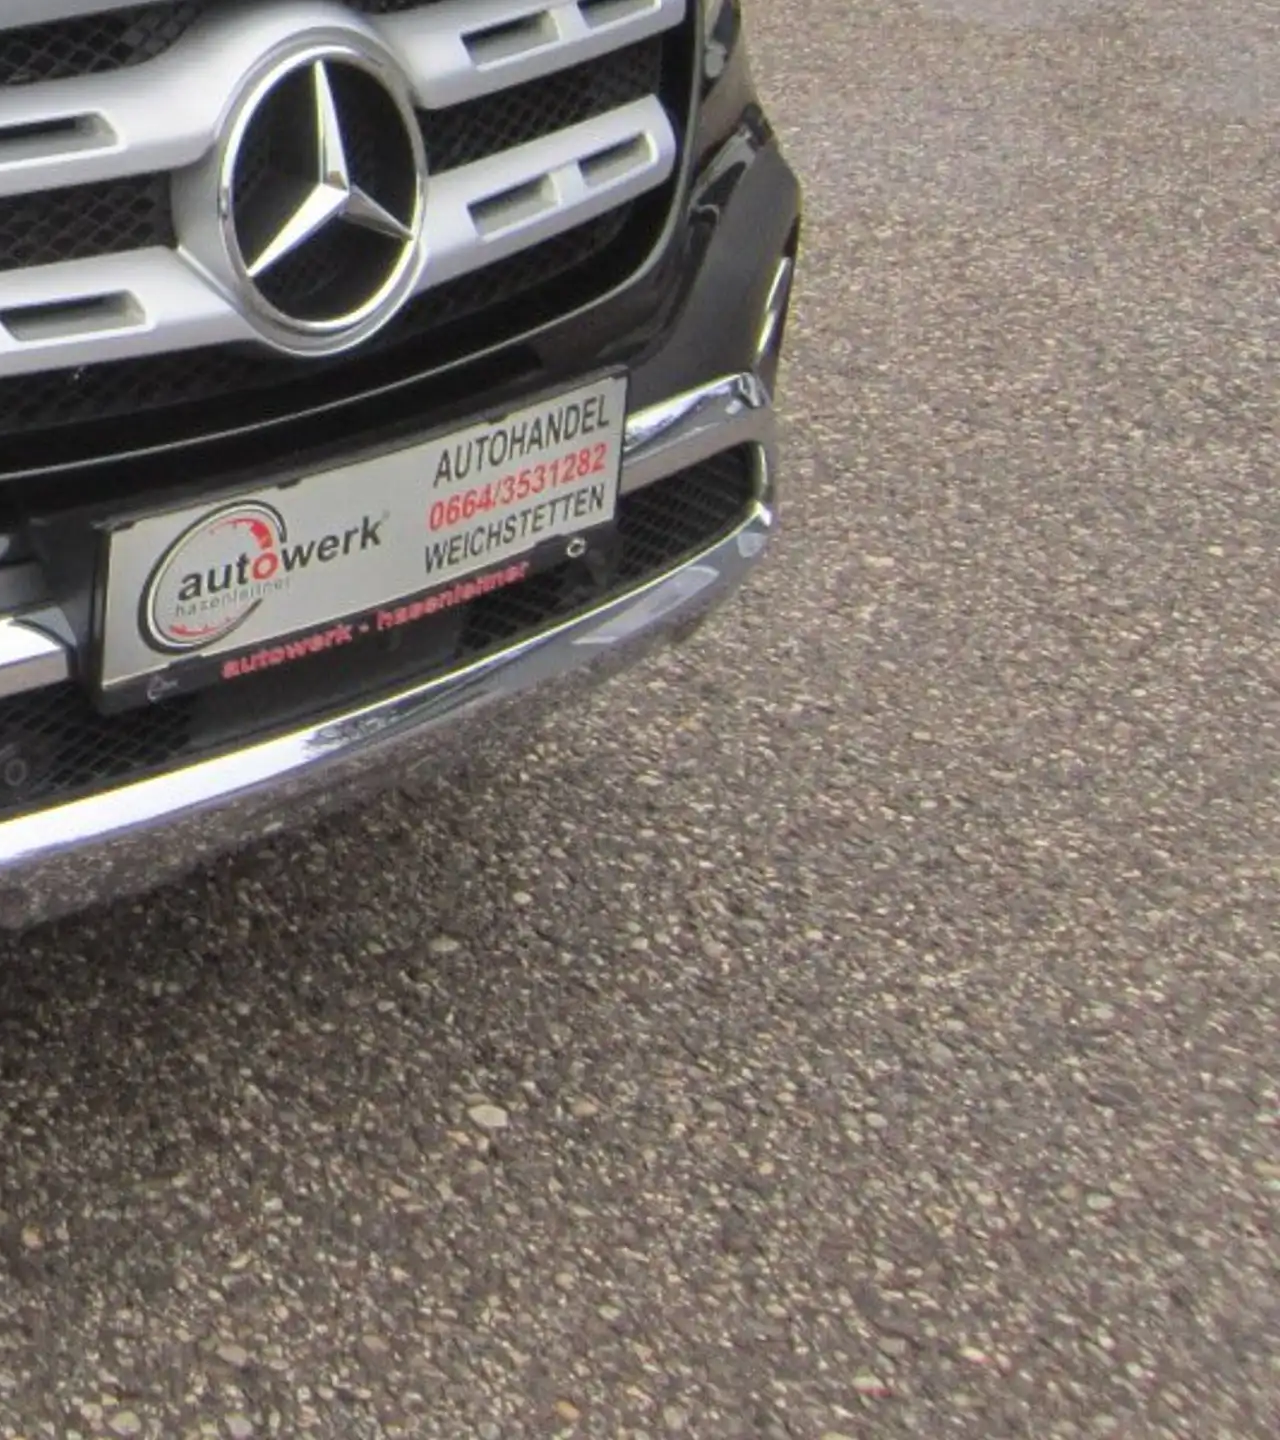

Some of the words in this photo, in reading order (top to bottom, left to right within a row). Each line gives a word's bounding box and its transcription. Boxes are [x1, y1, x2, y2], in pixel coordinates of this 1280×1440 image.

[428, 441, 608, 533] 0664/3531282
[433, 393, 610, 488] AUTOHANDEL
[423, 482, 605, 575] WEICHSTETTEN
